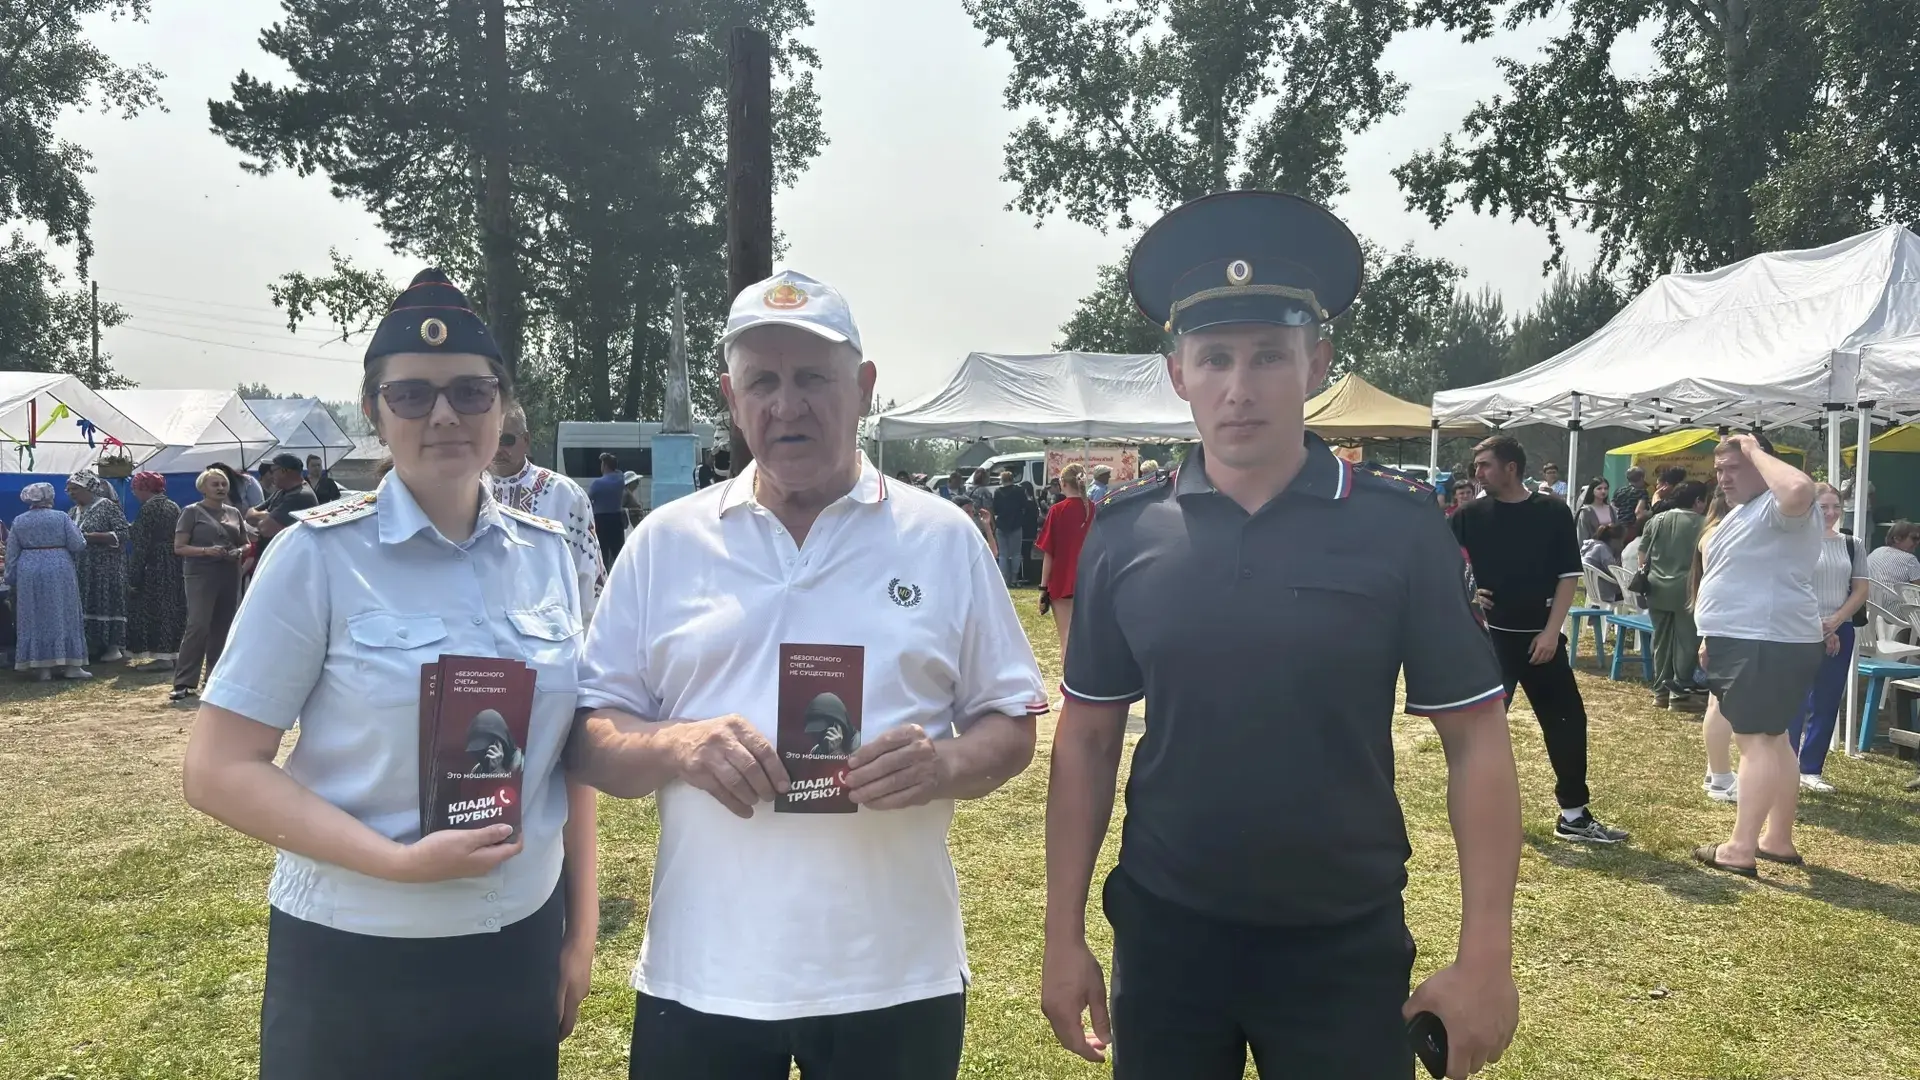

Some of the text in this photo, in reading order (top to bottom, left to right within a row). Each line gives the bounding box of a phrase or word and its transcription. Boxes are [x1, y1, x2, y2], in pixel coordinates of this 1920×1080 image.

[790, 654, 842, 663] «БЕЗОПАСНОГО
[455, 670, 505, 678] «БЕЗОПАСНОГО
[799, 670, 845, 678] СУЩЕСТВУЕТ!
[785, 751, 801, 759] Это
[447, 771, 462, 779] Это
[787, 786, 841, 803] ТРУБКУ!
[448, 795, 495, 813] КЛАДИ
[448, 807, 503, 825] ТРУБКУ!
